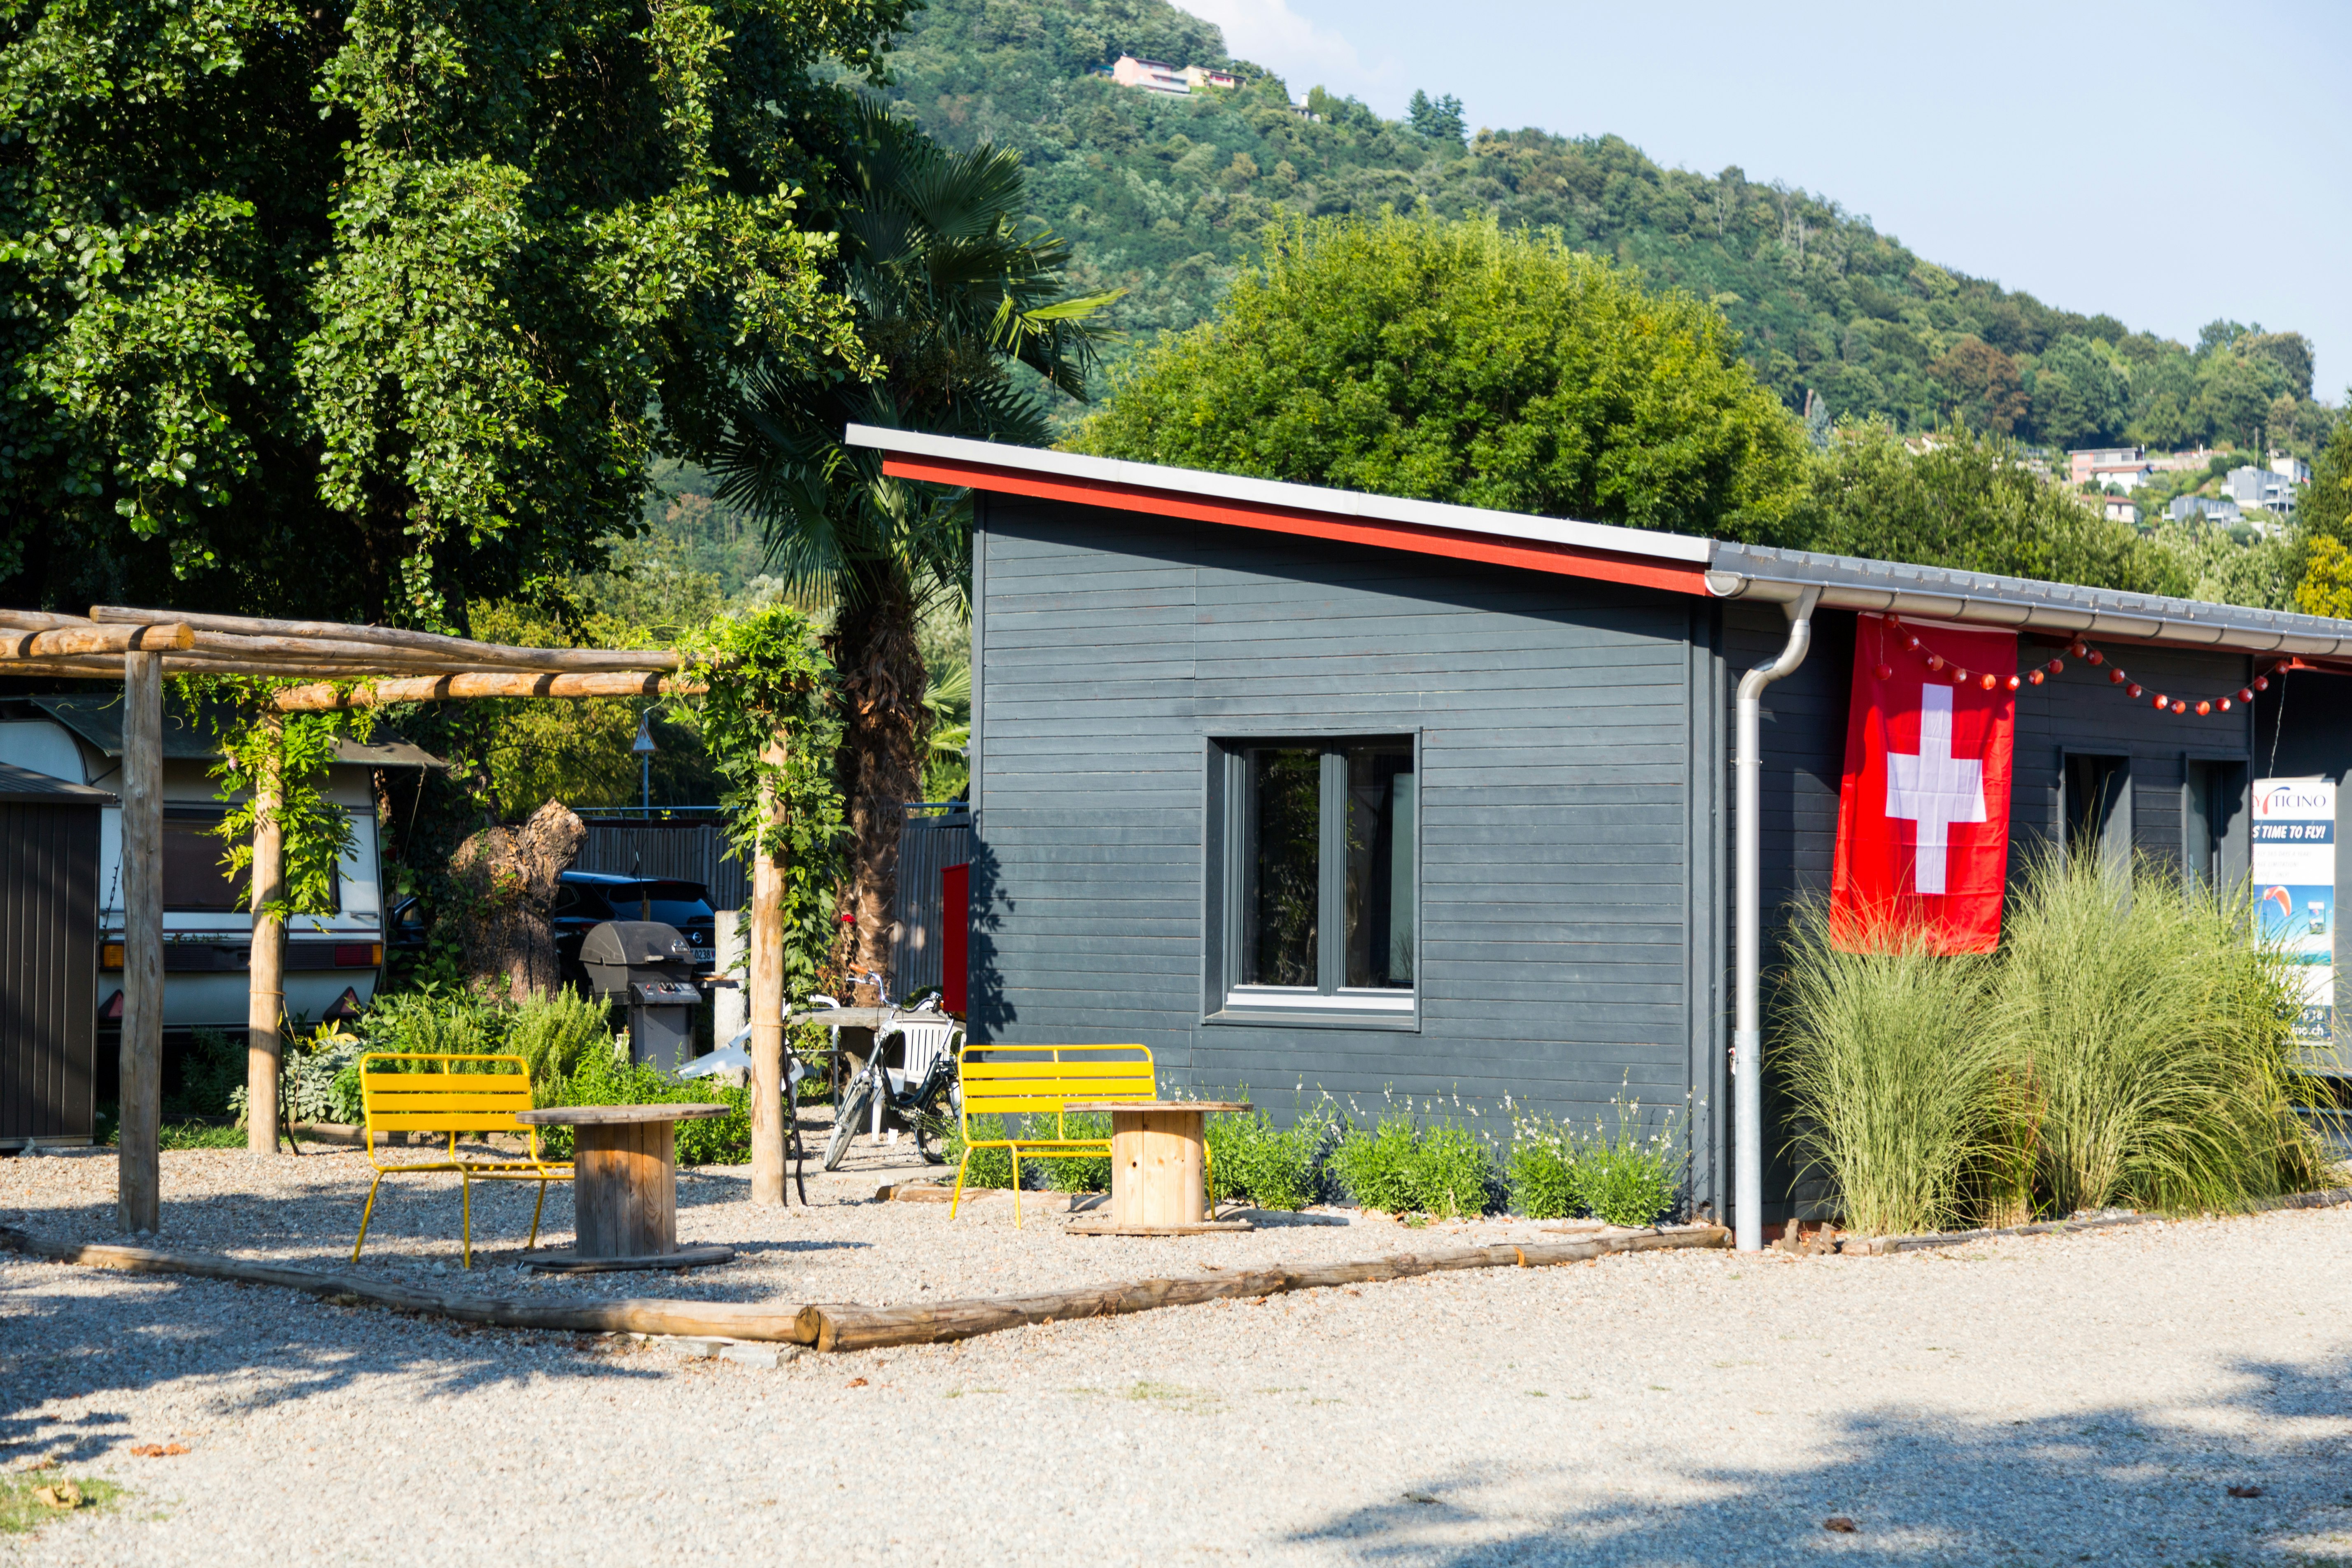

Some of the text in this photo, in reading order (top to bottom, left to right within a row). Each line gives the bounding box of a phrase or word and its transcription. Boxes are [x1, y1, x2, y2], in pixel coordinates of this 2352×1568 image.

[2273, 795, 2326, 807] TICINO
[2262, 825, 2288, 839] TIME
[2289, 825, 2303, 839] TO
[2305, 825, 2326, 839] FLY!
[692, 949, 711, 960] 0238
[2291, 1023, 2324, 1036] ino.ch
